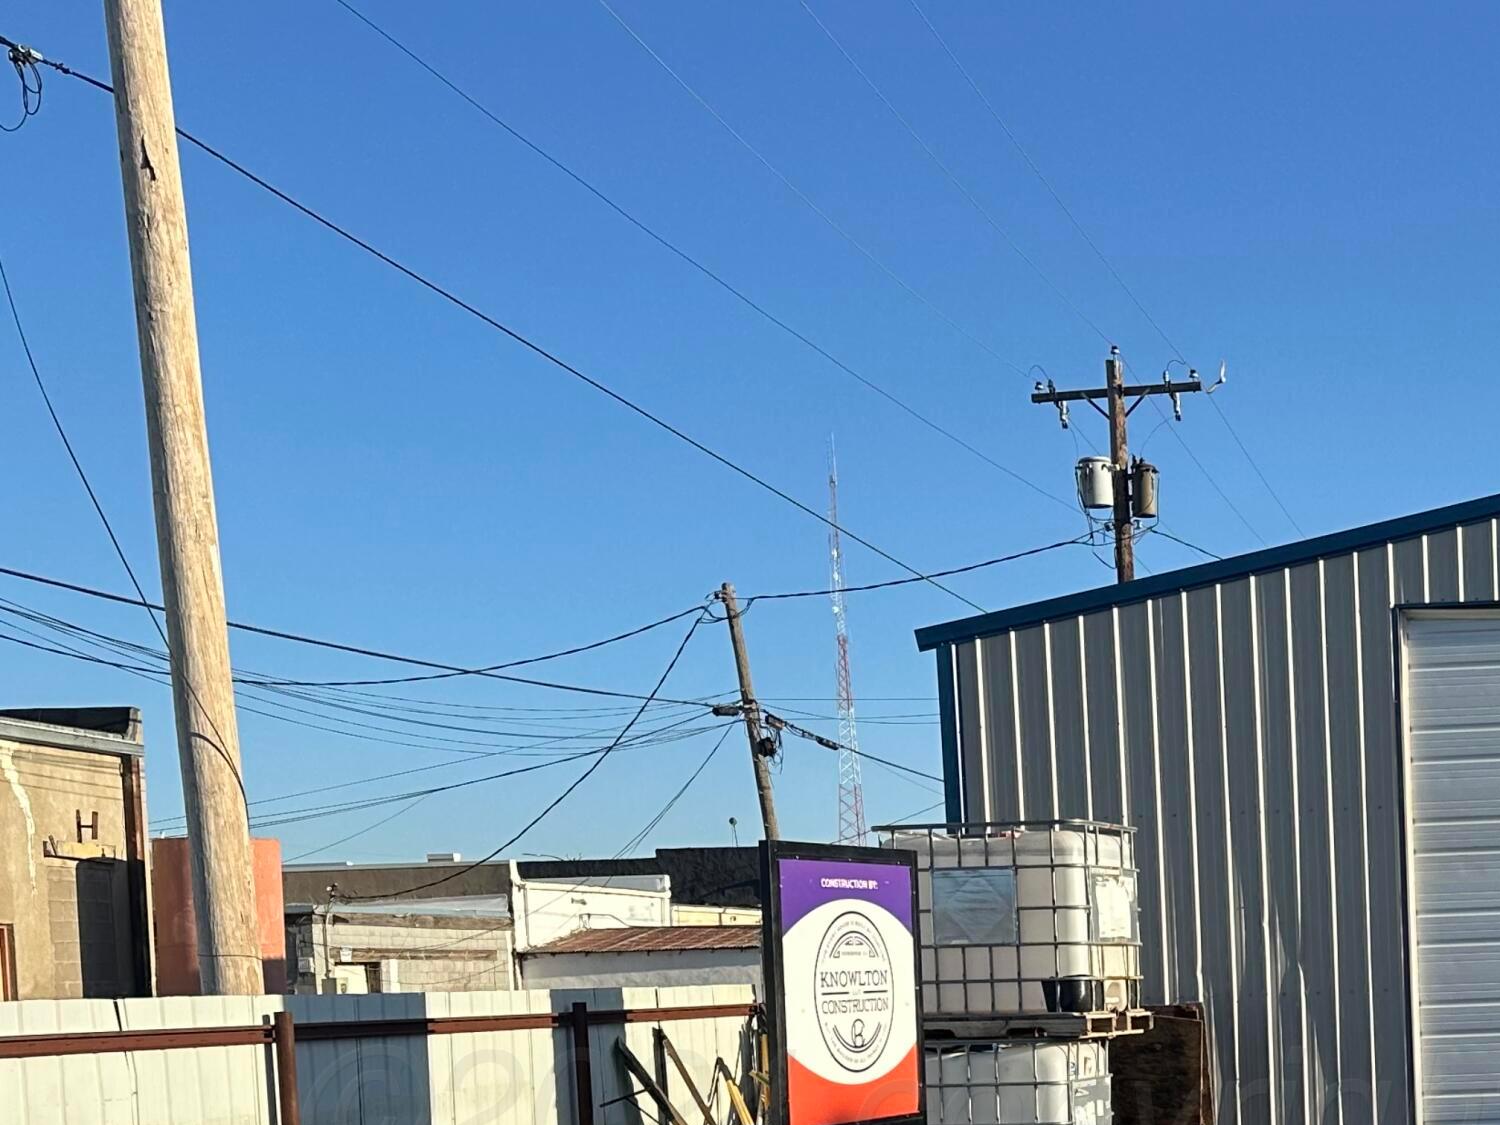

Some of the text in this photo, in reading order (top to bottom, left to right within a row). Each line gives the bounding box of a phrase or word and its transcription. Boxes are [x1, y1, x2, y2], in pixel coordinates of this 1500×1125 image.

[820, 877, 868, 890] CONSTRUCTION
[820, 969, 889, 988] KNOWLTON
[821, 996, 889, 1015] CONSTRUCTION
